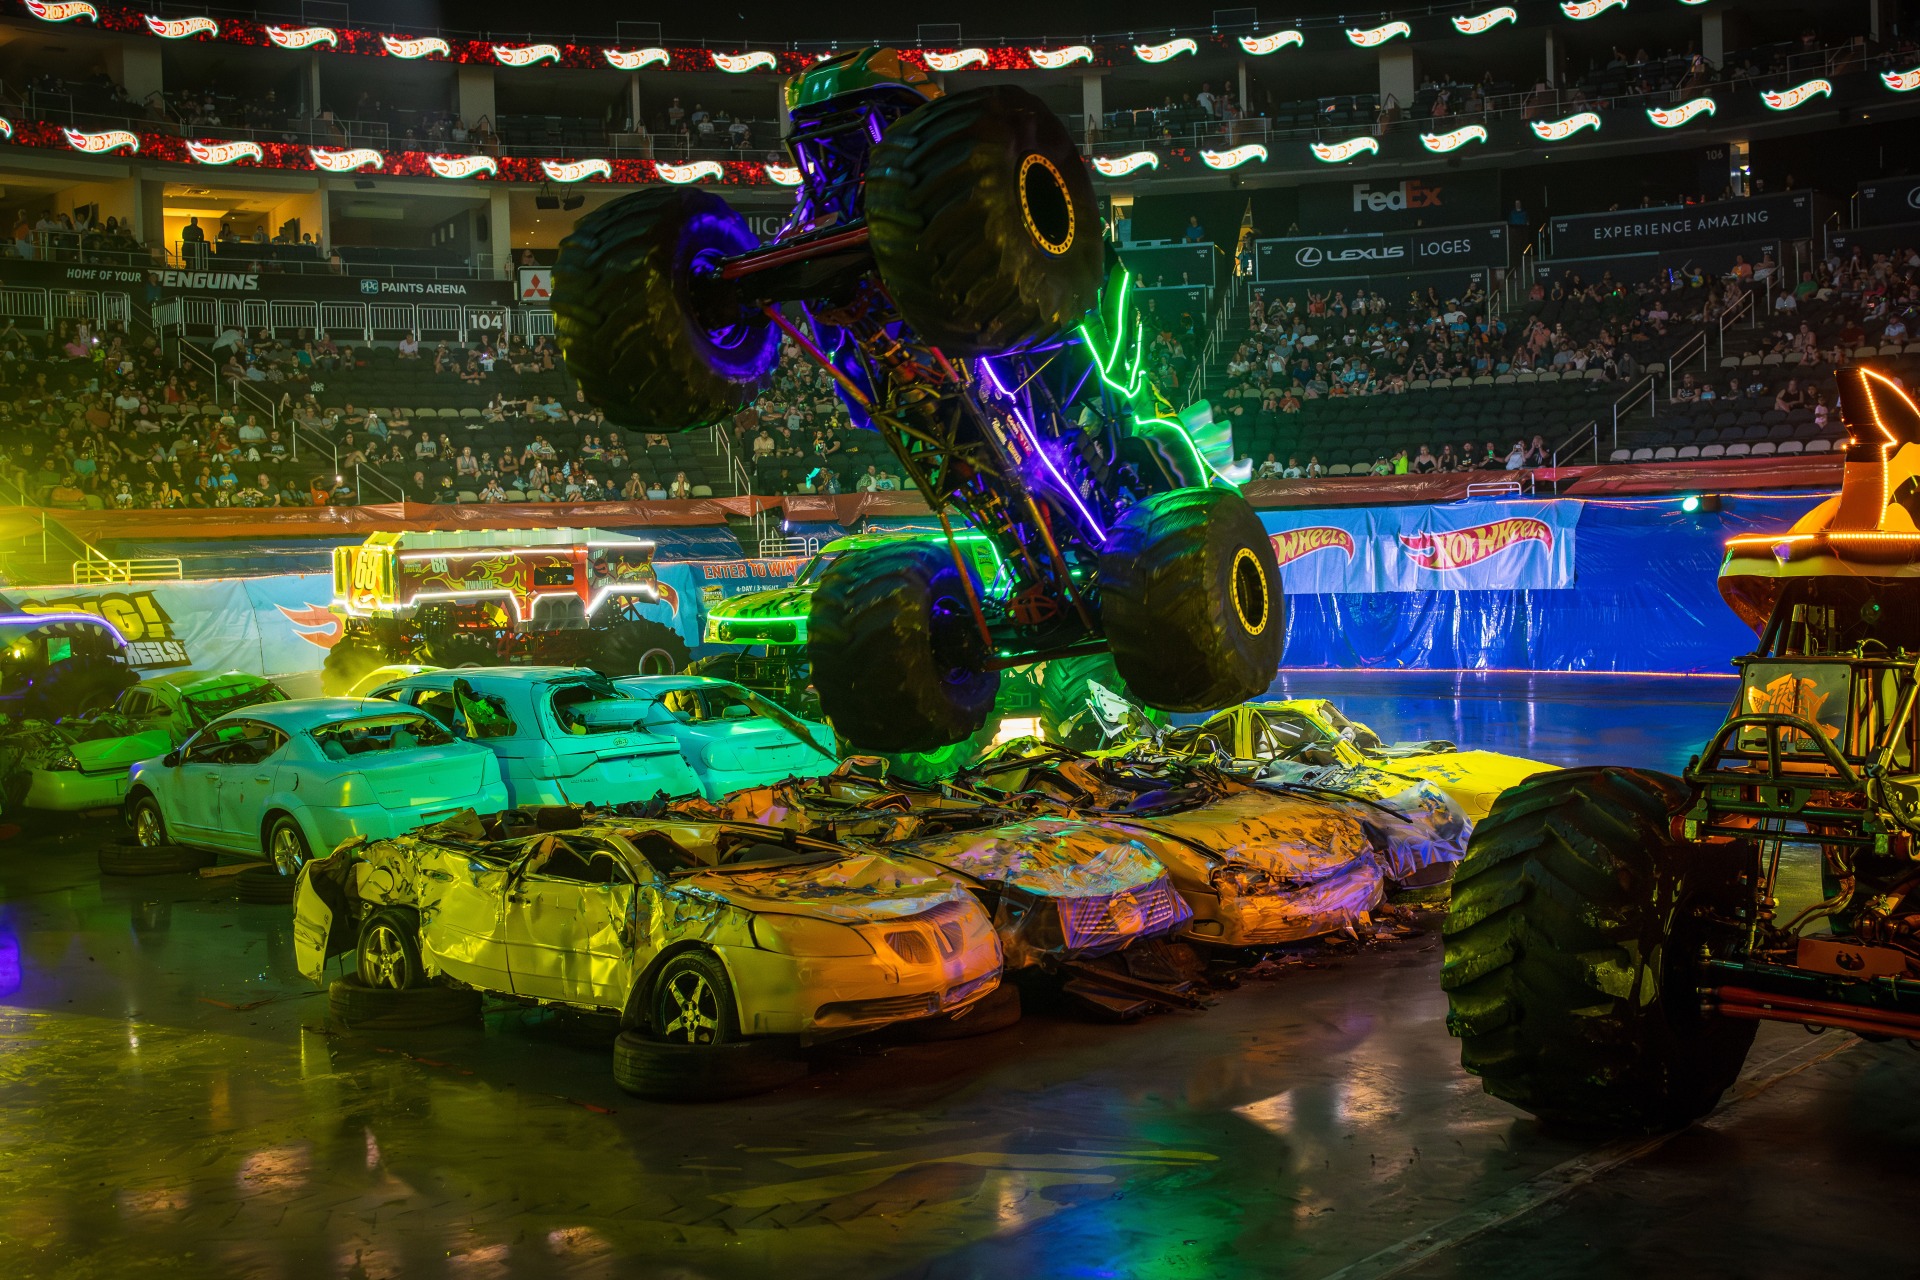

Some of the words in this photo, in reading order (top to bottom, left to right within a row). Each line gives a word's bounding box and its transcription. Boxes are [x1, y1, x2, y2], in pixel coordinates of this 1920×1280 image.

[1706, 149, 1724, 160] 106
[1353, 180, 1442, 212] FedEx
[1594, 220, 1692, 240] EXPERIENCE
[1697, 210, 1769, 230] AMAZING
[1327, 245, 1404, 262] LEXUS
[1420, 239, 1471, 256] LOGES
[67, 268, 97, 279] HOME
[100, 270, 111, 280] OF
[115, 271, 141, 282] YOUR
[361, 281, 378, 292] PPG
[381, 282, 424, 293] PAINTS
[426, 283, 467, 294] ARENA
[470, 314, 502, 330] 104
[1276, 528, 1348, 564] WHEELS
[1430, 534, 1475, 568] HOT
[1470, 519, 1545, 560] WHEELS
[354, 551, 378, 590] 68
[431, 557, 449, 573] 68
[703, 563, 748, 579] ENTER
[749, 562, 766, 577] TO
[768, 560, 797, 577] WIN
